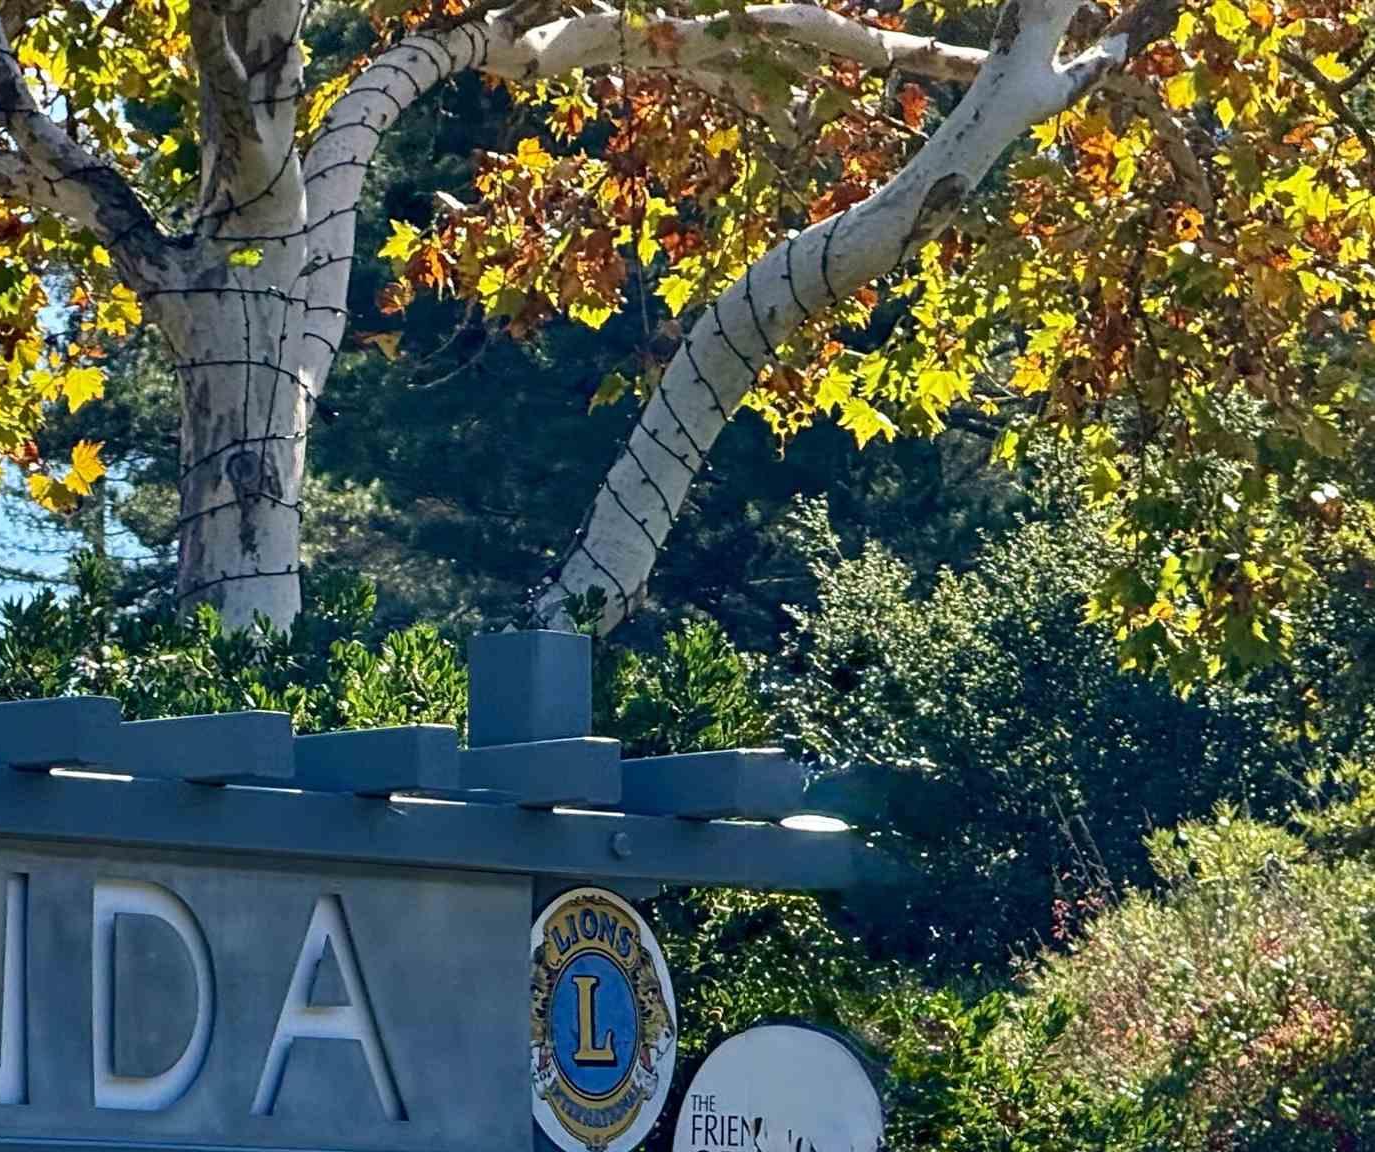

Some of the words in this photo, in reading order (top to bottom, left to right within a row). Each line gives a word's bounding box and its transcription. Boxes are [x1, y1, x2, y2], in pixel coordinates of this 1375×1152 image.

[550, 907, 635, 958] LIONS
[572, 975, 618, 1067] L
[691, 1095, 716, 1112] THE
